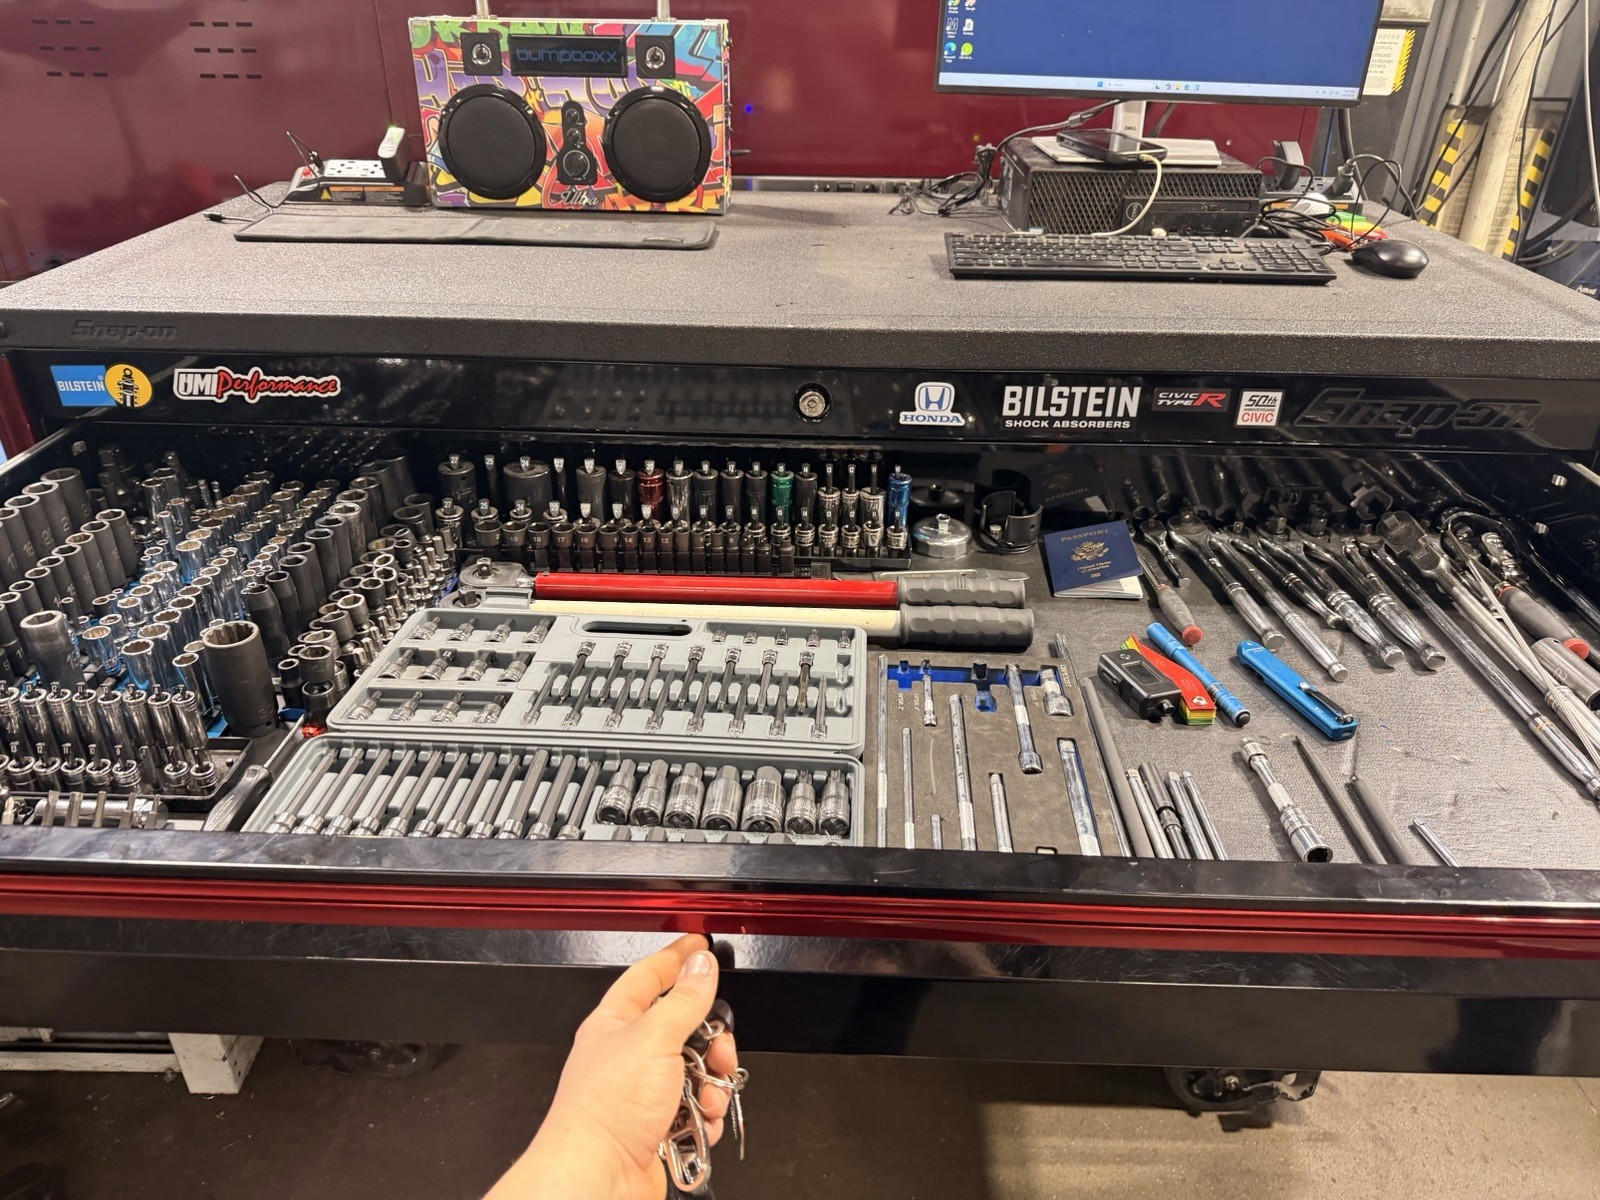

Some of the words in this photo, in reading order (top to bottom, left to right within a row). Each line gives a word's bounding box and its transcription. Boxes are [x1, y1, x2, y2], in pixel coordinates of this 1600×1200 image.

[516, 47, 617, 63] bumpboxx
[560, 189, 600, 206] Ultra
[72, 319, 176, 343] Snap-on
[57, 380, 105, 393] BILSTEIN
[178, 373, 218, 396] UMI
[216, 370, 337, 399] Performance
[1002, 386, 1142, 418] BILSTEIN
[1193, 392, 1227, 408] R
[1244, 394, 1278, 408] 50th
[902, 414, 963, 424] HONDA
[1241, 412, 1275, 423] CIVIC
[1294, 387, 1546, 438] Snap-on
[1005, 419, 1050, 428] SHOCK
[1052, 420, 1131, 429] ABSORBERS
[1060, 528, 1110, 542] PASSPORT
